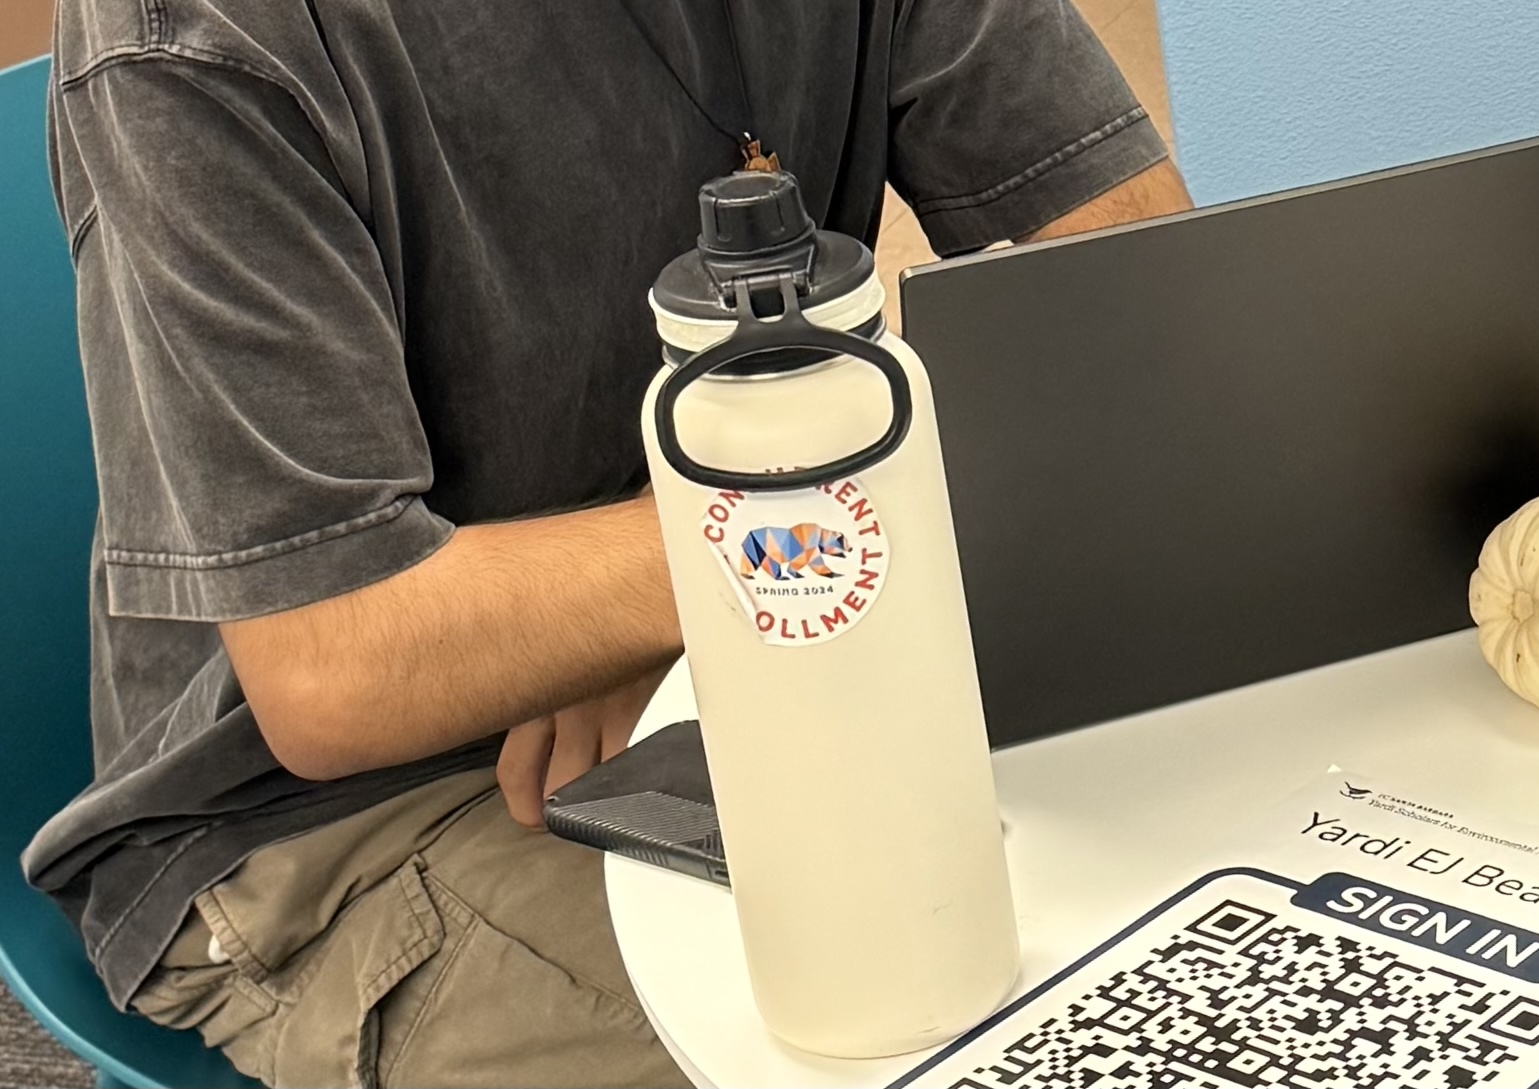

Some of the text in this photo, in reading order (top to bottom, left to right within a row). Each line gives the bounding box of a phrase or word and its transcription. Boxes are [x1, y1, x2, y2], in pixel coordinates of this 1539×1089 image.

[703, 466, 881, 543] CONENT
[755, 547, 883, 639] OLLMENT
[804, 585, 834, 596] 2024
[1301, 811, 1412, 860] Yardi
[1406, 848, 1465, 875] EJ
[1325, 886, 1472, 946] SIGN
